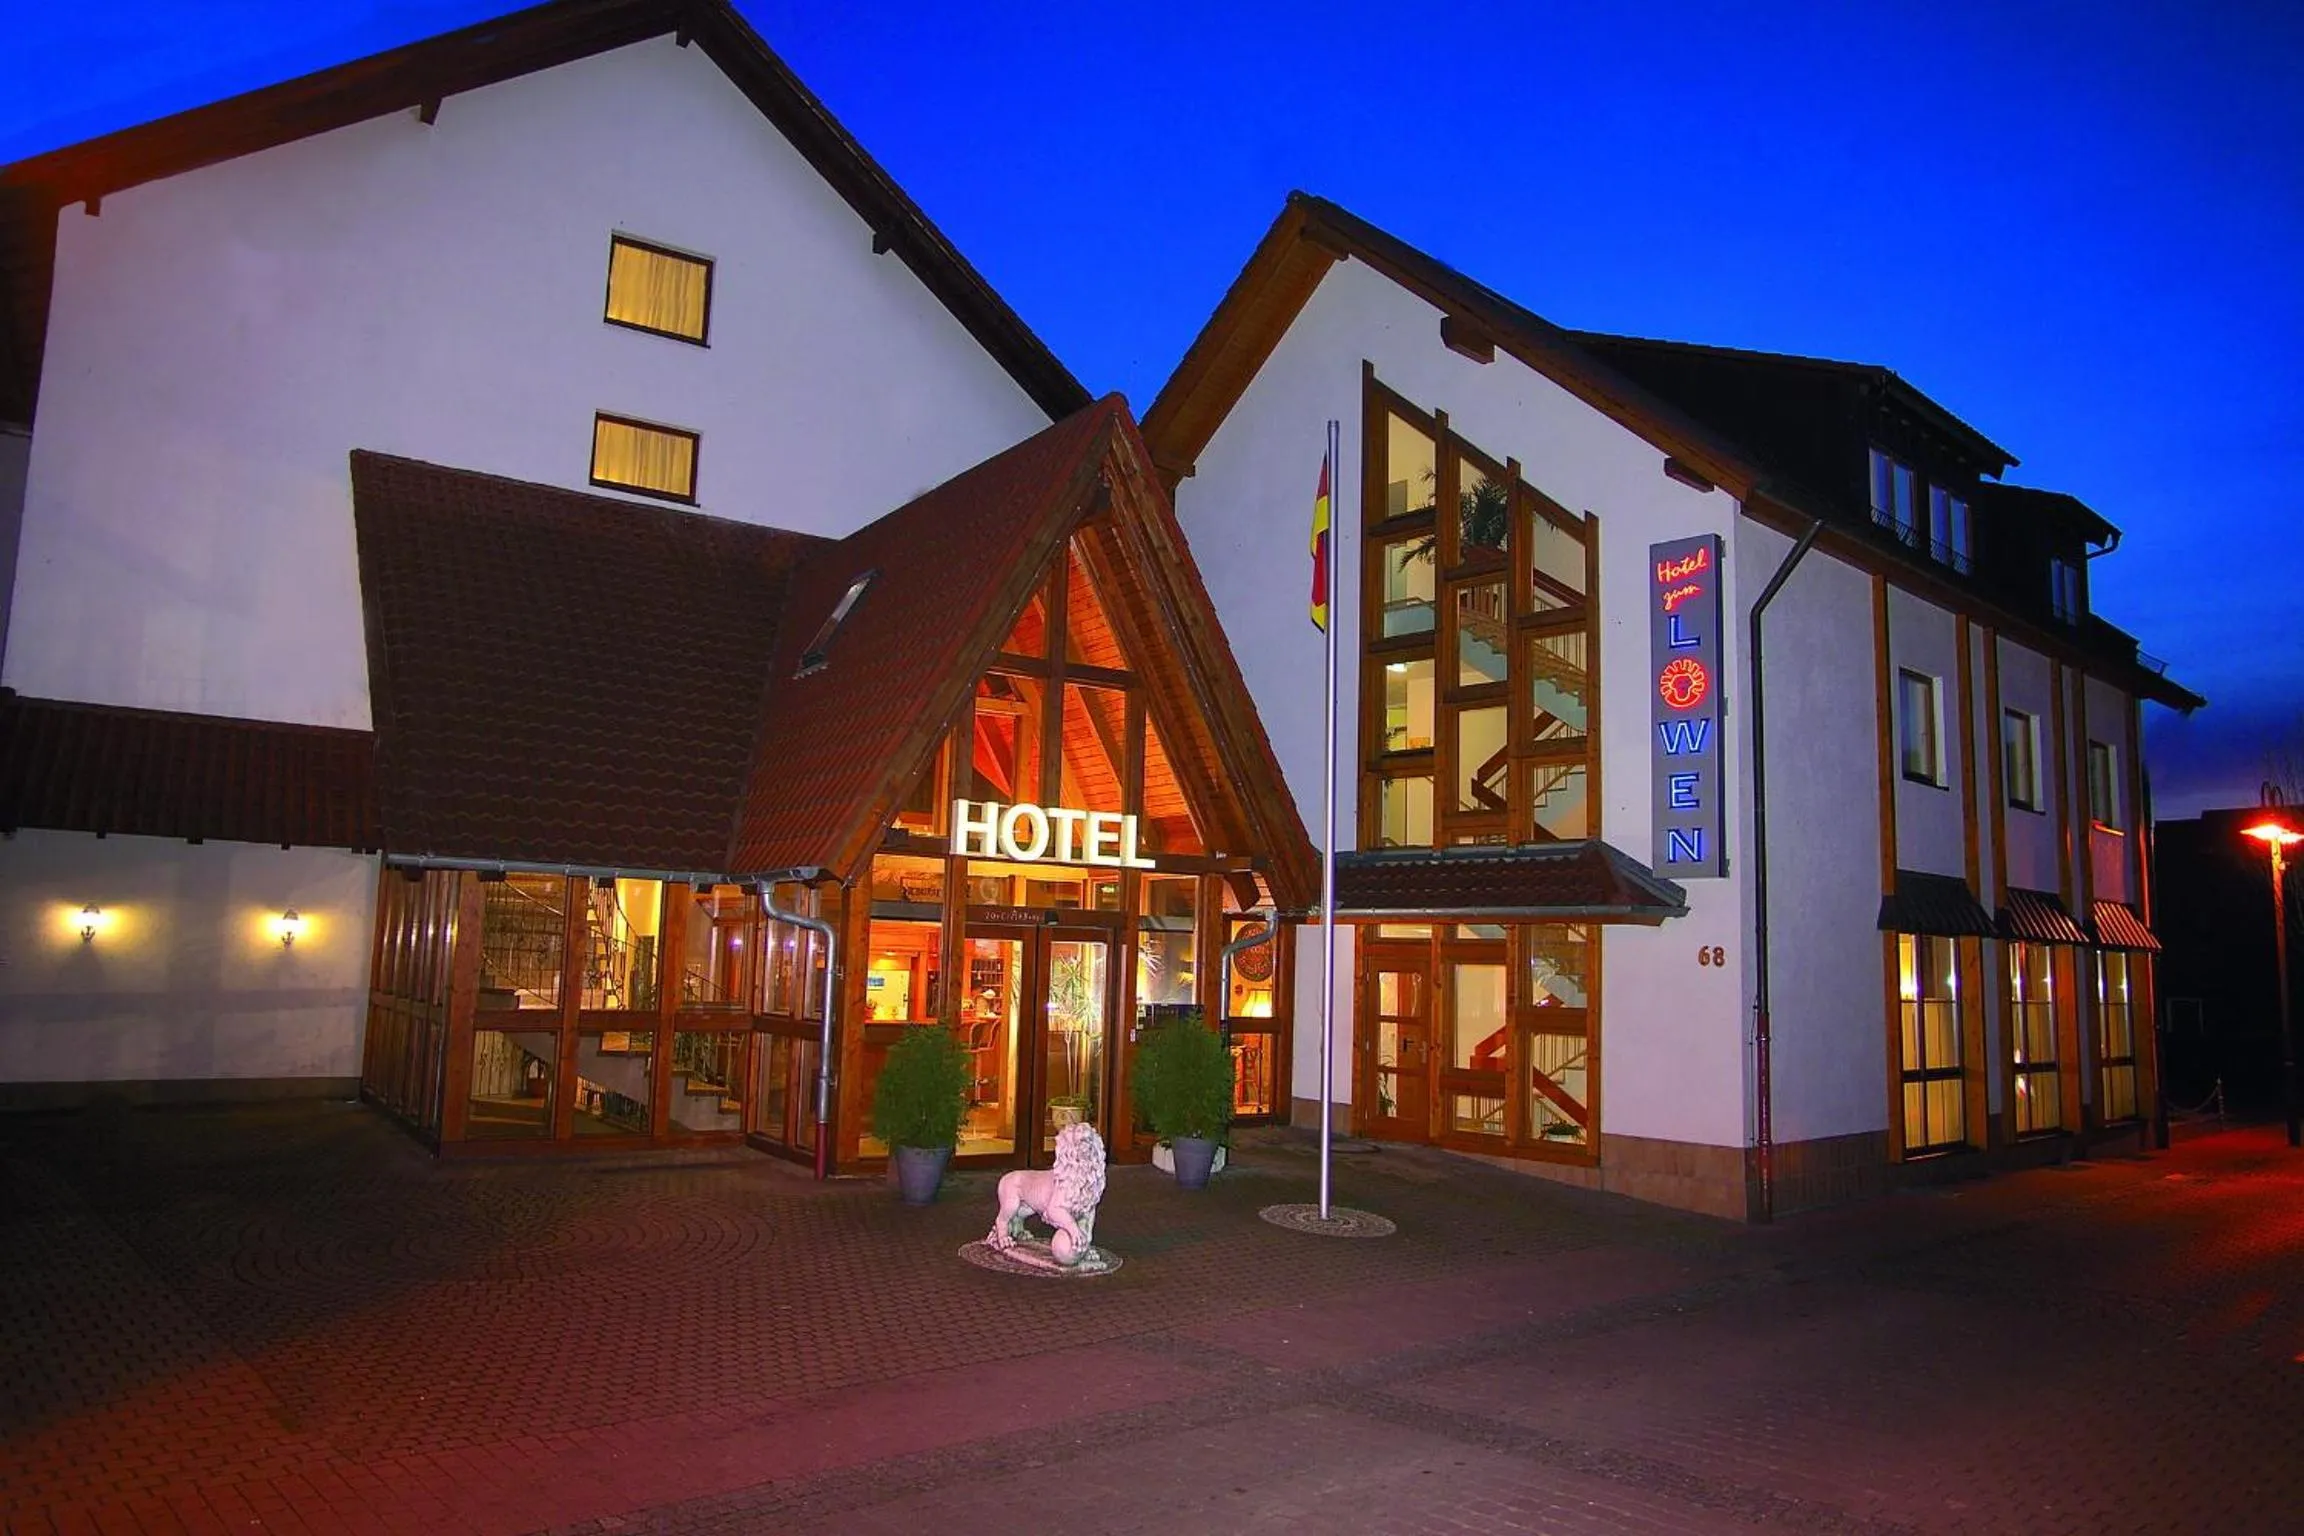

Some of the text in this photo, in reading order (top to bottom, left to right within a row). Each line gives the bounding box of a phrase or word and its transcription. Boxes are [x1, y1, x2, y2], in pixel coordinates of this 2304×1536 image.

[1656, 547, 1708, 583] Hotel
[1662, 584, 1702, 611] zum
[950, 798, 1156, 868] HOTEL
[1698, 945, 1726, 968] 68
